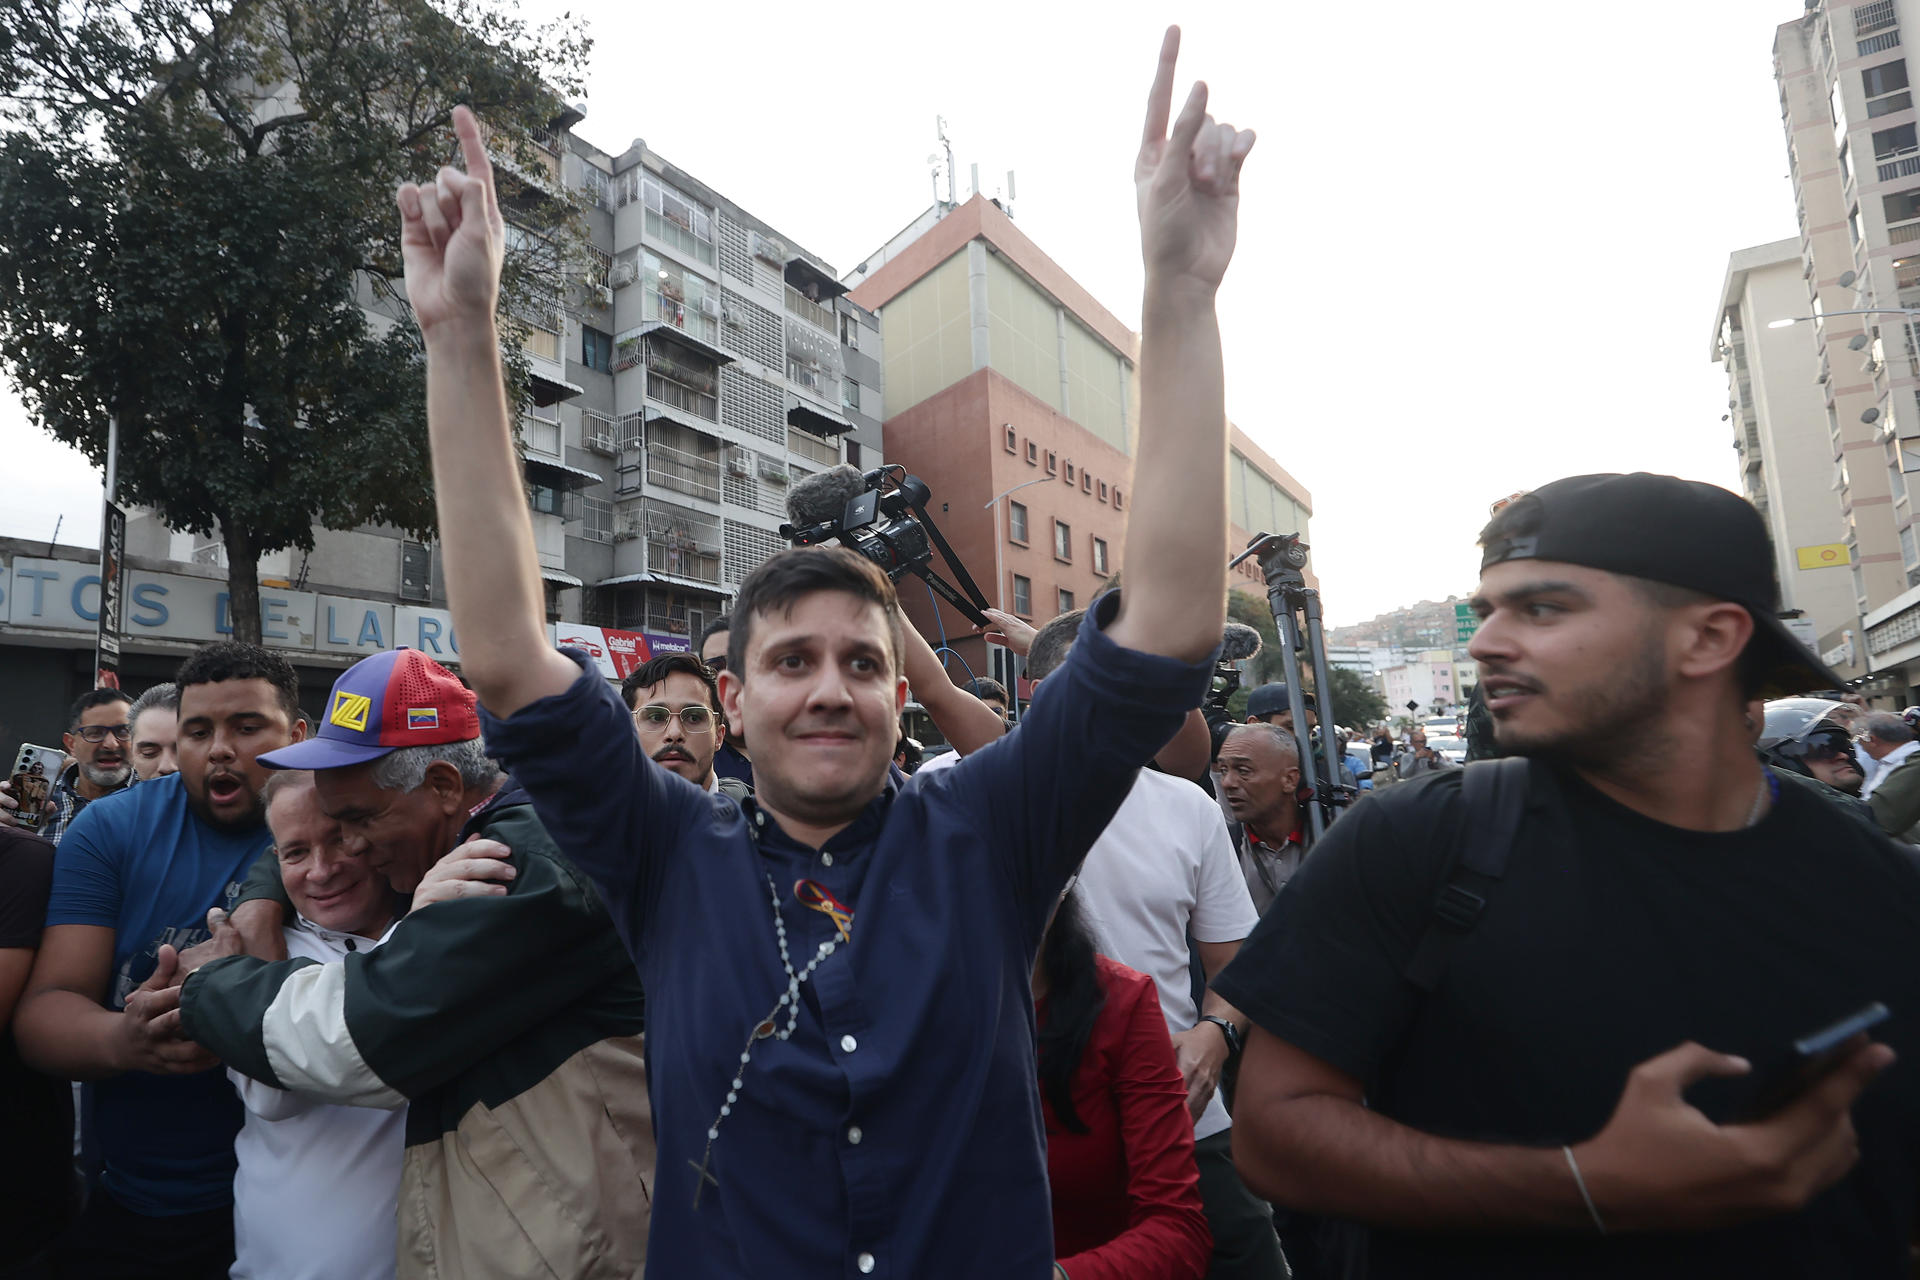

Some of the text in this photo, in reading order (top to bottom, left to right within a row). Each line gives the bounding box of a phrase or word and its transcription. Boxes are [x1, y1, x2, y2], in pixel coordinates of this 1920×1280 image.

[0, 567, 169, 627] TOS
[328, 605, 385, 648] LA
[608, 635, 636, 649] Gabriel
